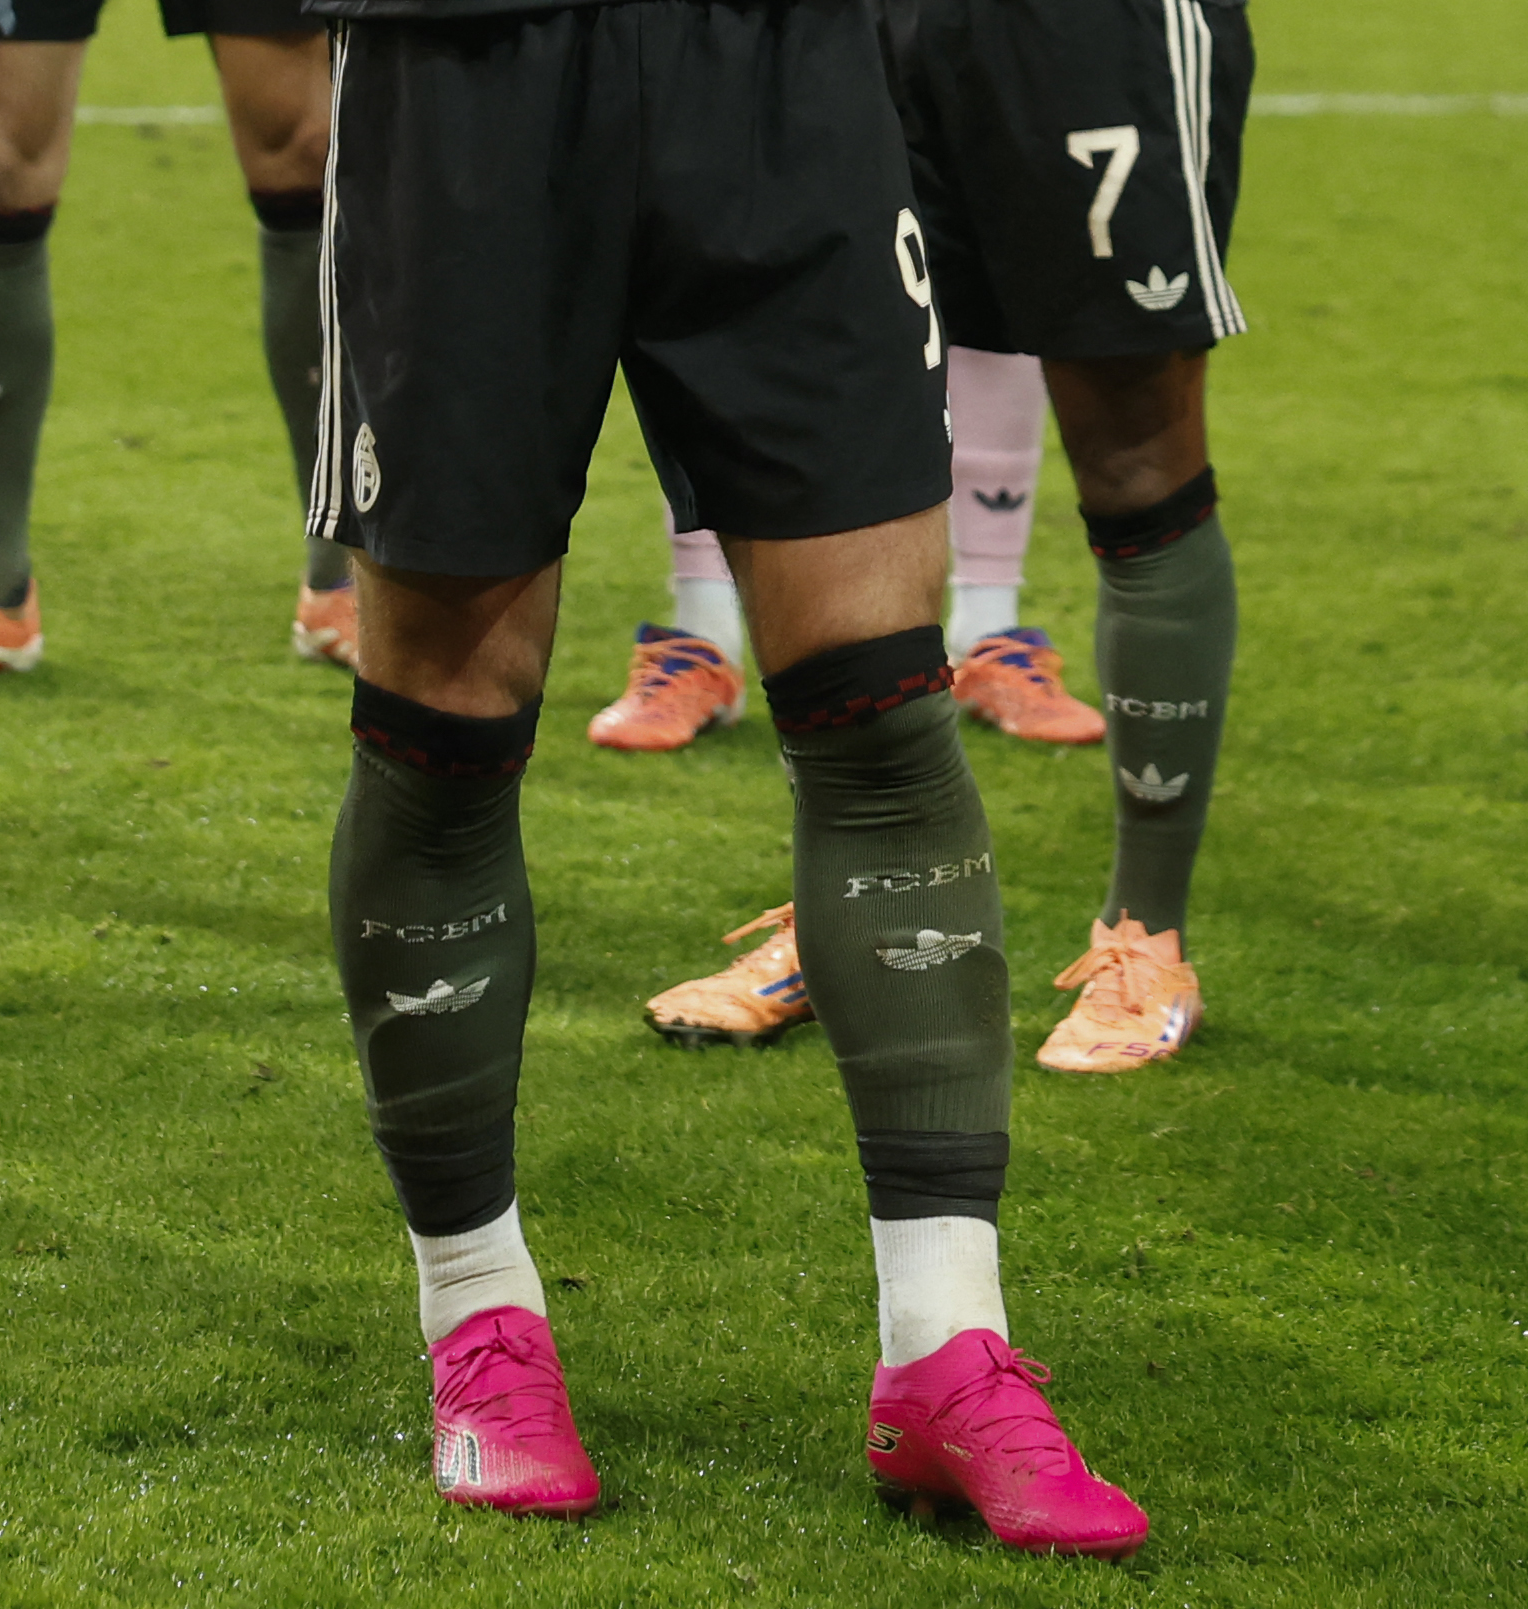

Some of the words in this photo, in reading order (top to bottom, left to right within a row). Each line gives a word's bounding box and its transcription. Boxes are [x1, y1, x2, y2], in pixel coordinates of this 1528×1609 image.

[1066, 124, 1141, 259] 7
[895, 207, 941, 370] 9
[1105, 693, 1209, 721] FCBM
[842, 851, 992, 900] FCBM
[360, 902, 508, 943] FCBM
